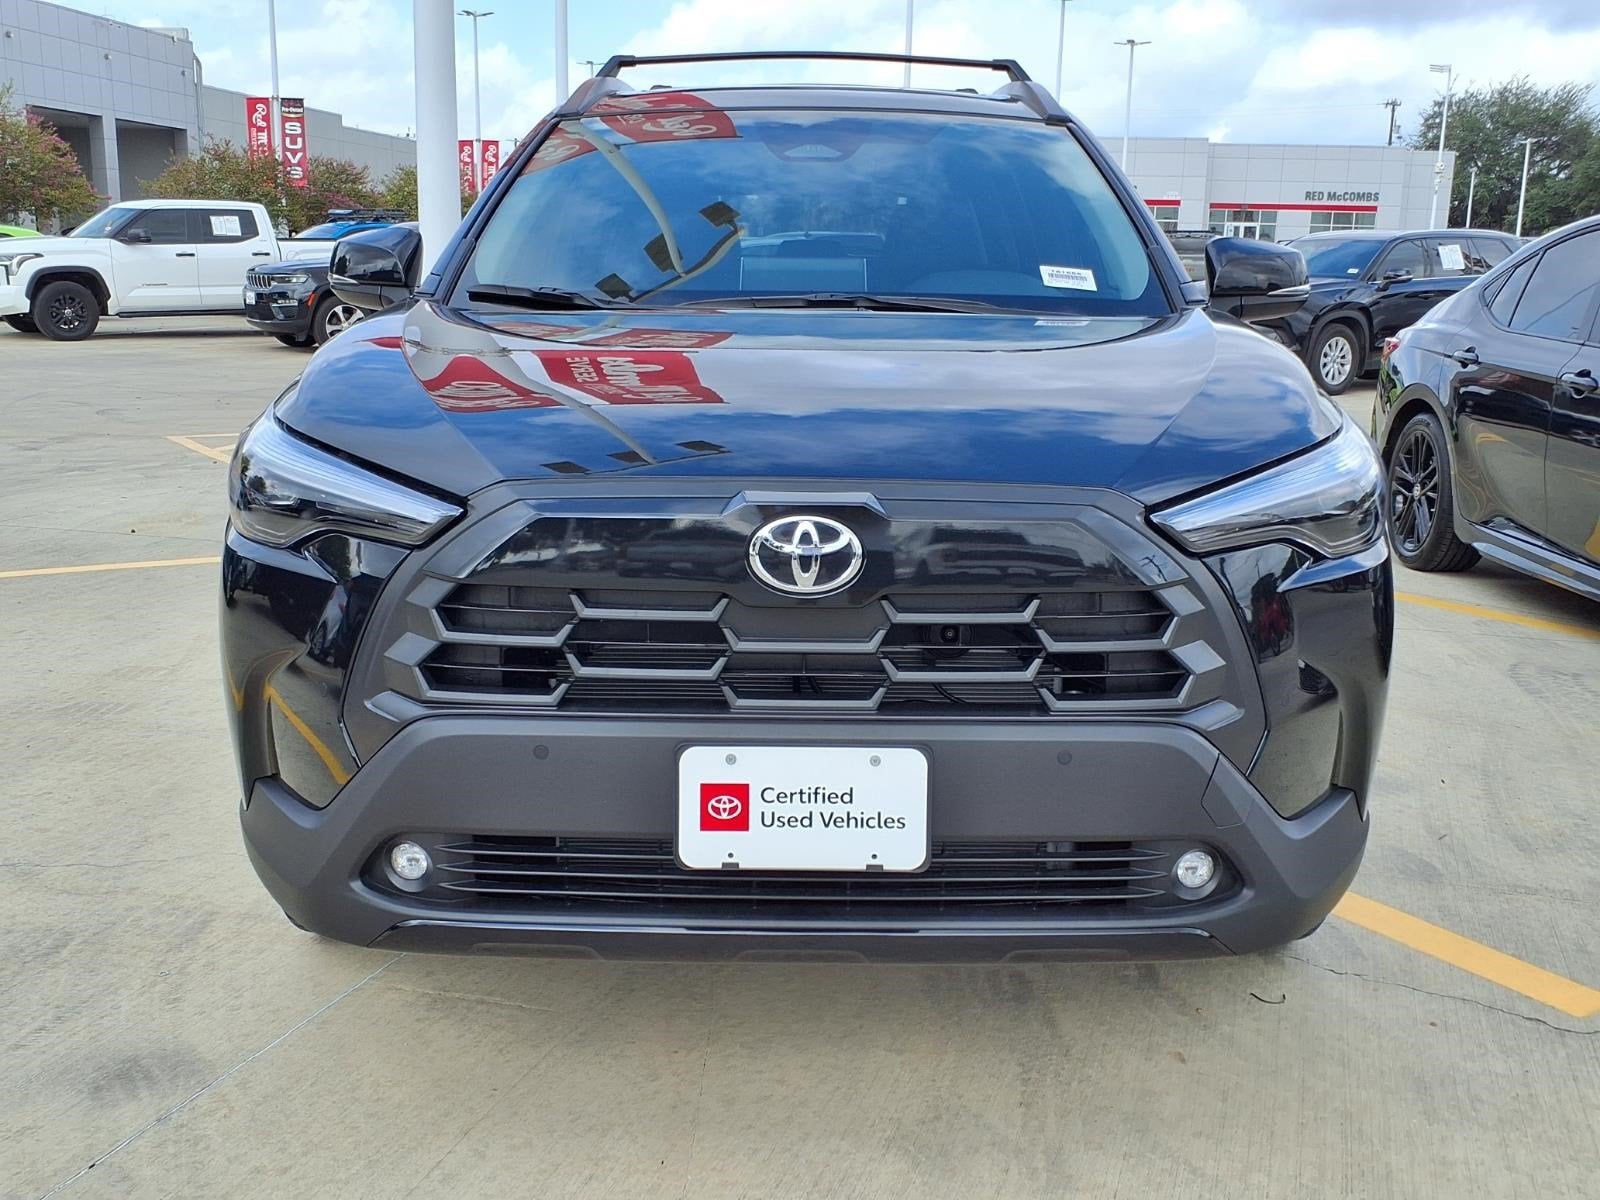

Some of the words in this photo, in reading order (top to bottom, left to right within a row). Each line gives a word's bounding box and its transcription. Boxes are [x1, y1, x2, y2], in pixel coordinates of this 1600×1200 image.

[252, 103, 267, 127] Red
[1305, 191, 1324, 201] RED
[1327, 192, 1380, 202] McCOMBS
[760, 786, 854, 805] Certified
[760, 811, 813, 829] Used
[819, 811, 906, 830] Vehicles
